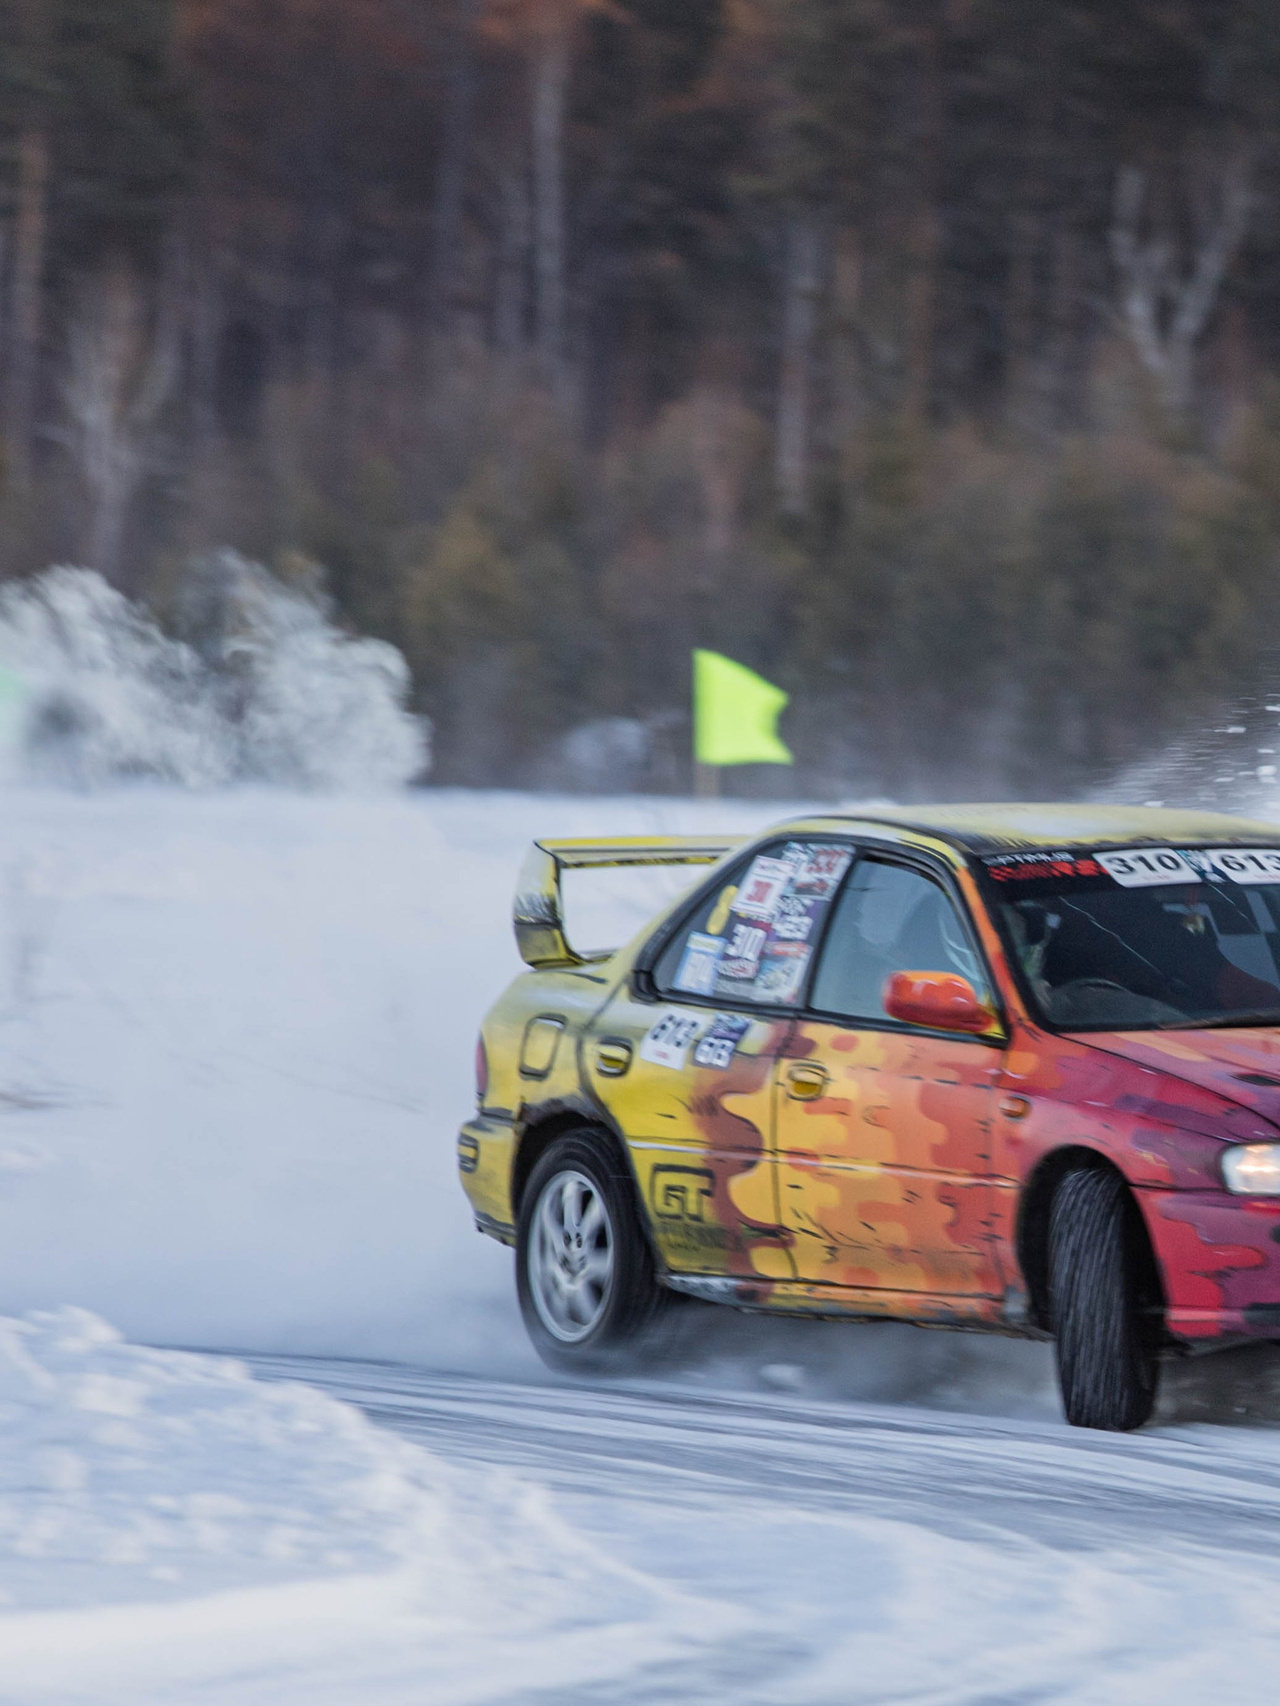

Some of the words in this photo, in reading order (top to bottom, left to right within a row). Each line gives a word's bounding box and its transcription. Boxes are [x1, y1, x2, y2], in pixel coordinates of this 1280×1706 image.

[1104, 854, 1181, 875] 310
[651, 1013, 699, 1050] 613
[650, 1163, 716, 1223] GT
